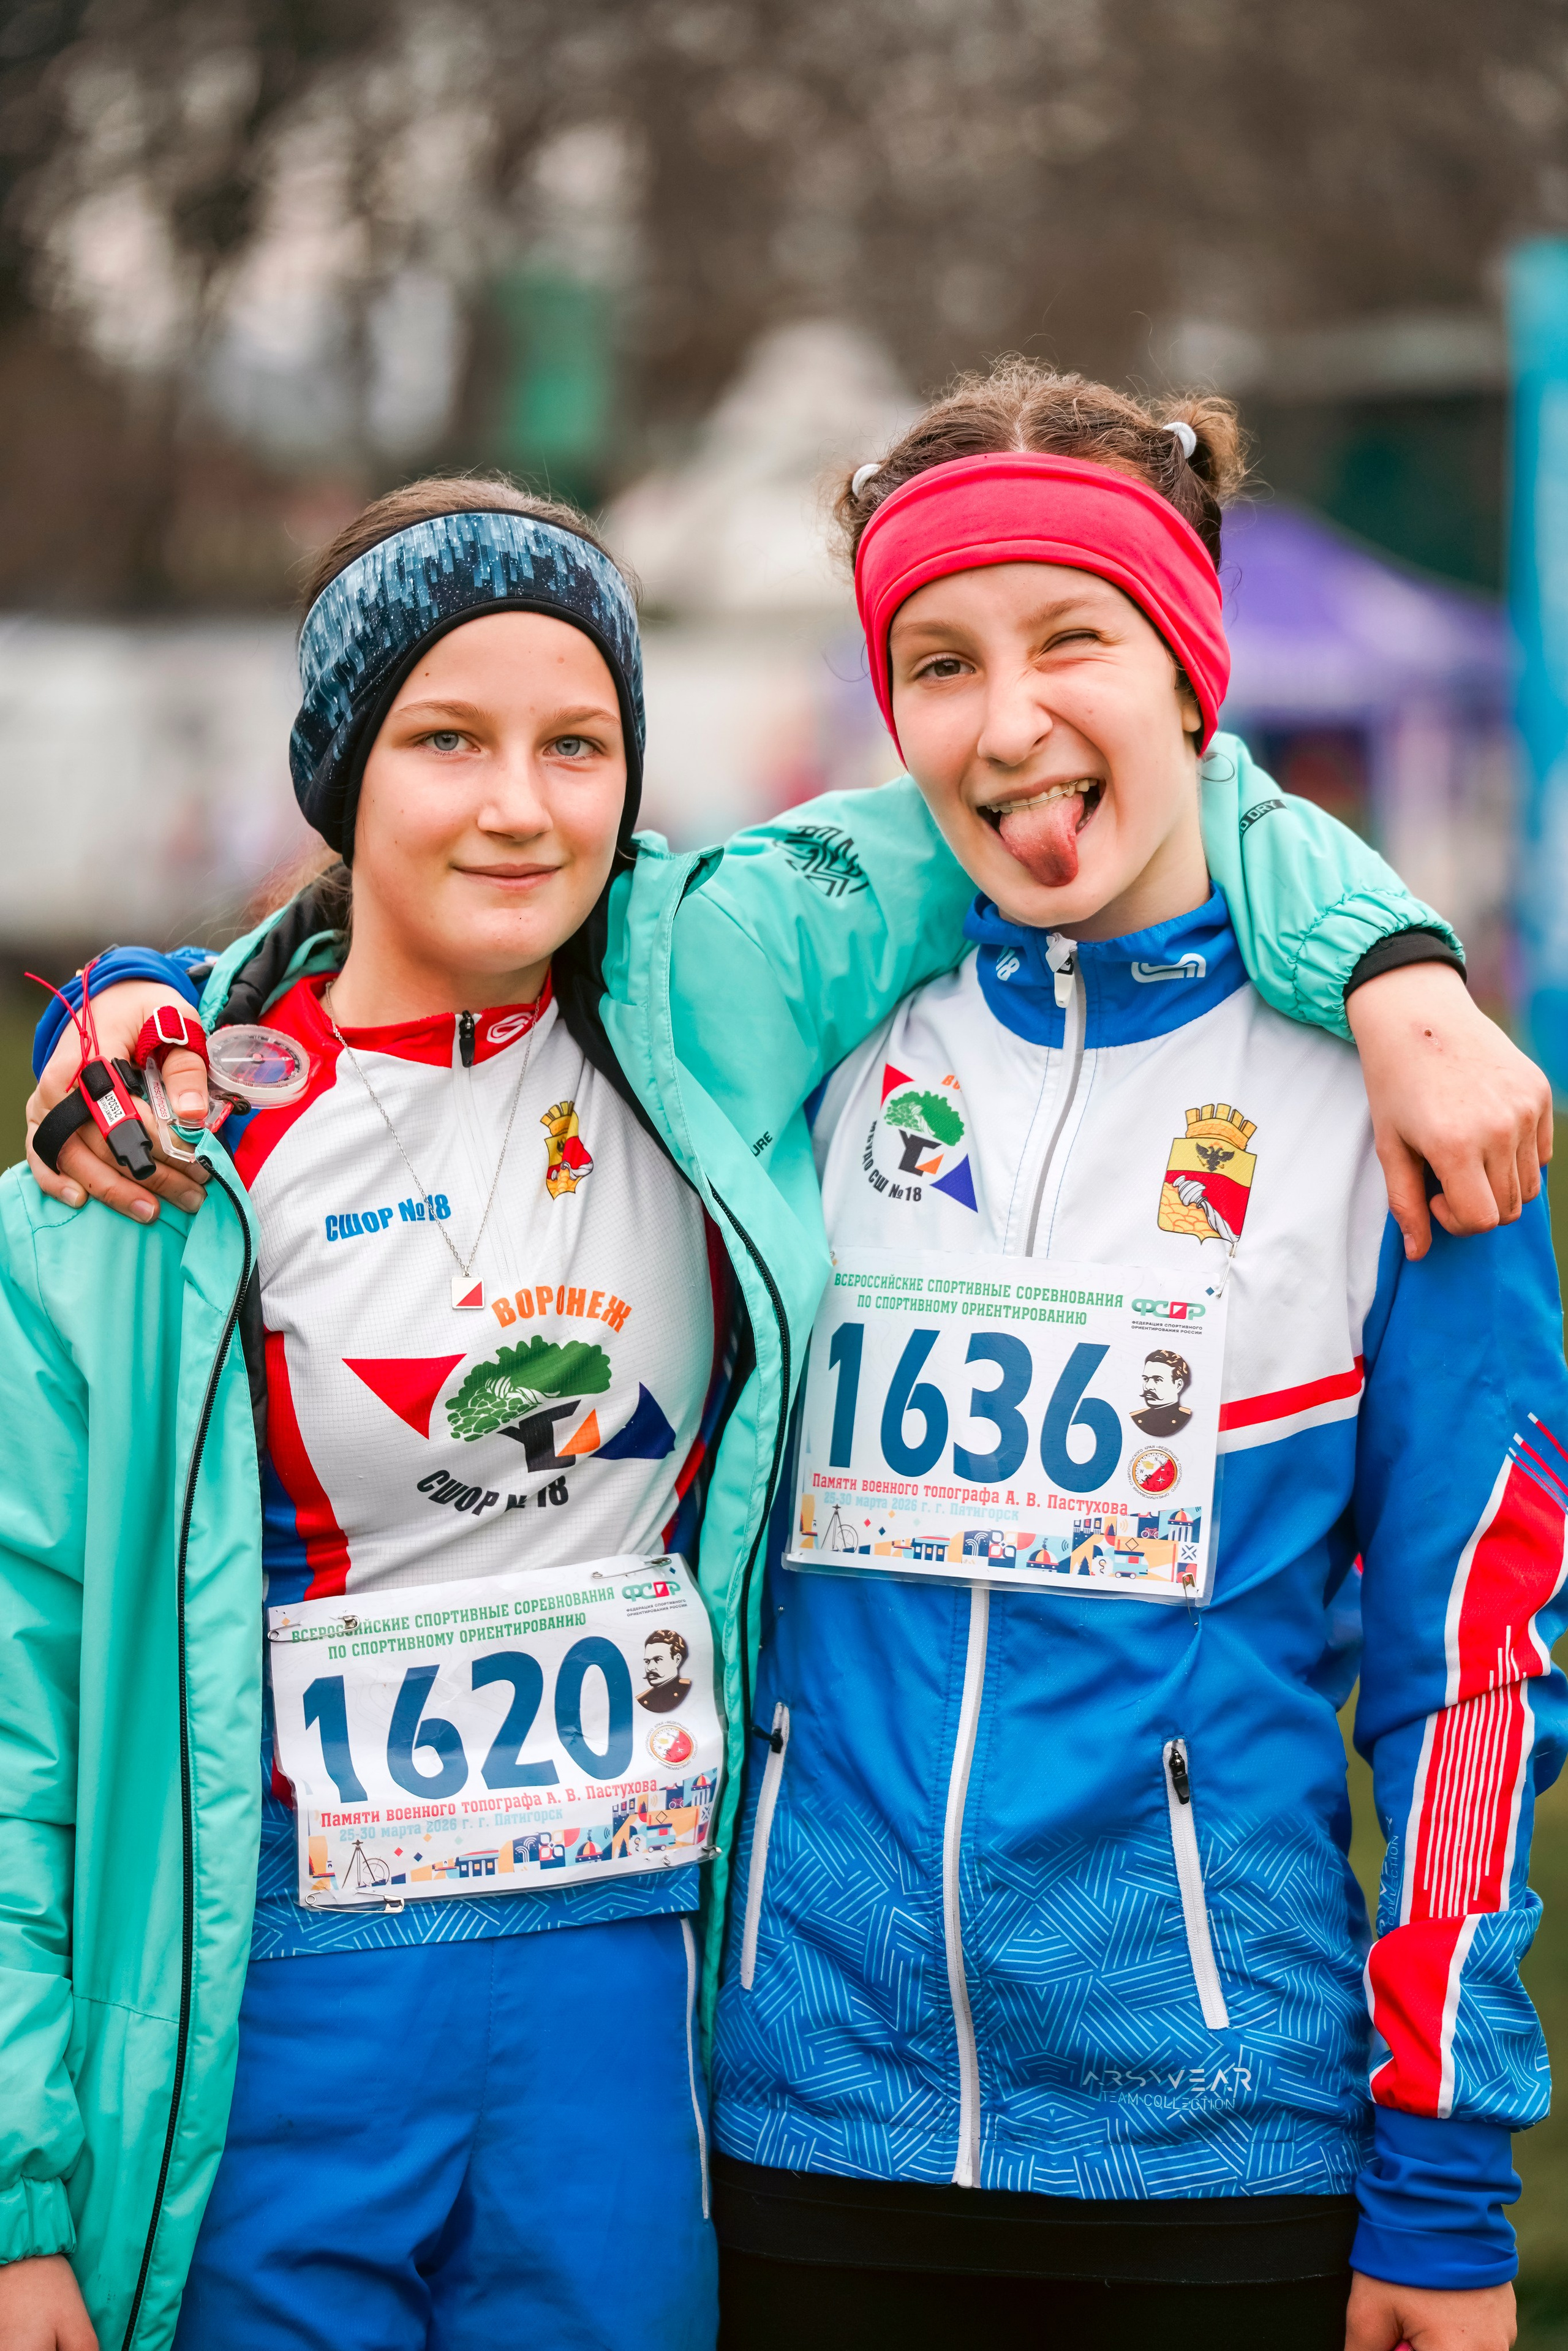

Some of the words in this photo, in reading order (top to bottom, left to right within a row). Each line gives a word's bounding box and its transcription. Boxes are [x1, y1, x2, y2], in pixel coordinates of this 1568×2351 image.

[1247, 801, 1276, 820] DRY
[105, 1093, 123, 1118] 2153247
[868, 1169, 889, 1193] СШ
[325, 1207, 393, 1242] СШОР
[834, 1273, 924, 1292] ВСЕРОССИЙСКИЕ
[927, 1278, 1011, 1298] СПОРТИВНЫЕ
[1016, 1285, 1123, 1308] СОРЕВНОВАНИЯ
[491, 1285, 632, 1333] ВОРОНЕЖ
[857, 1294, 872, 1308] ПО
[875, 1296, 958, 1314] СПОРТИВНОМУ
[962, 1302, 1087, 1326] ОРИЕНТИРОВАНИЮ
[828, 1322, 1123, 1493] 1636
[417, 1470, 499, 1516] СШОР
[812, 1473, 858, 1490] Памяти
[861, 1479, 918, 1496] военного
[923, 1485, 1000, 1505] топографа
[1005, 1490, 1020, 1506] А.
[1026, 1493, 1041, 1508] В.
[1047, 1494, 1128, 1515] Пастухова
[824, 1492, 852, 1506] 25-30
[856, 1495, 888, 1511] марта
[891, 1498, 918, 1512] 2026
[921, 1503, 931, 1513] г.
[935, 1503, 945, 1514] г.
[949, 1503, 1019, 1521] Пятигорск
[415, 1606, 509, 1634] СПОРТИВНЫЕ
[514, 1586, 616, 1615] СОРЕВНОВАНИЯ
[627, 1607, 669, 1617] ОРИЕНТИРОВАНИЯ
[654, 1599, 686, 1607] СПОРТИВНОГО
[328, 1644, 347, 1660] ПО
[352, 1631, 454, 1658] СПОРТИВНОМУ
[460, 1612, 587, 1643] ОРИЕНТИРОВАНИЮ
[303, 1636, 633, 1803] 1620
[321, 1809, 380, 1827] Памяти
[386, 1803, 456, 1821] военного
[461, 1792, 543, 1815] топографа
[548, 1792, 561, 1805] А.
[567, 1788, 581, 1802] В.
[586, 1779, 657, 1800] Пастухова
[339, 1827, 376, 1843] 25-30
[380, 1824, 421, 1840] марта
[426, 1817, 458, 1833] 2026
[462, 1818, 473, 1830] г.
[478, 1817, 489, 1828] г.
[494, 1808, 564, 1827] Пятигорск
[1101, 2091, 1139, 2107] TEAM
[1144, 2093, 1235, 2111] COLLECTION
